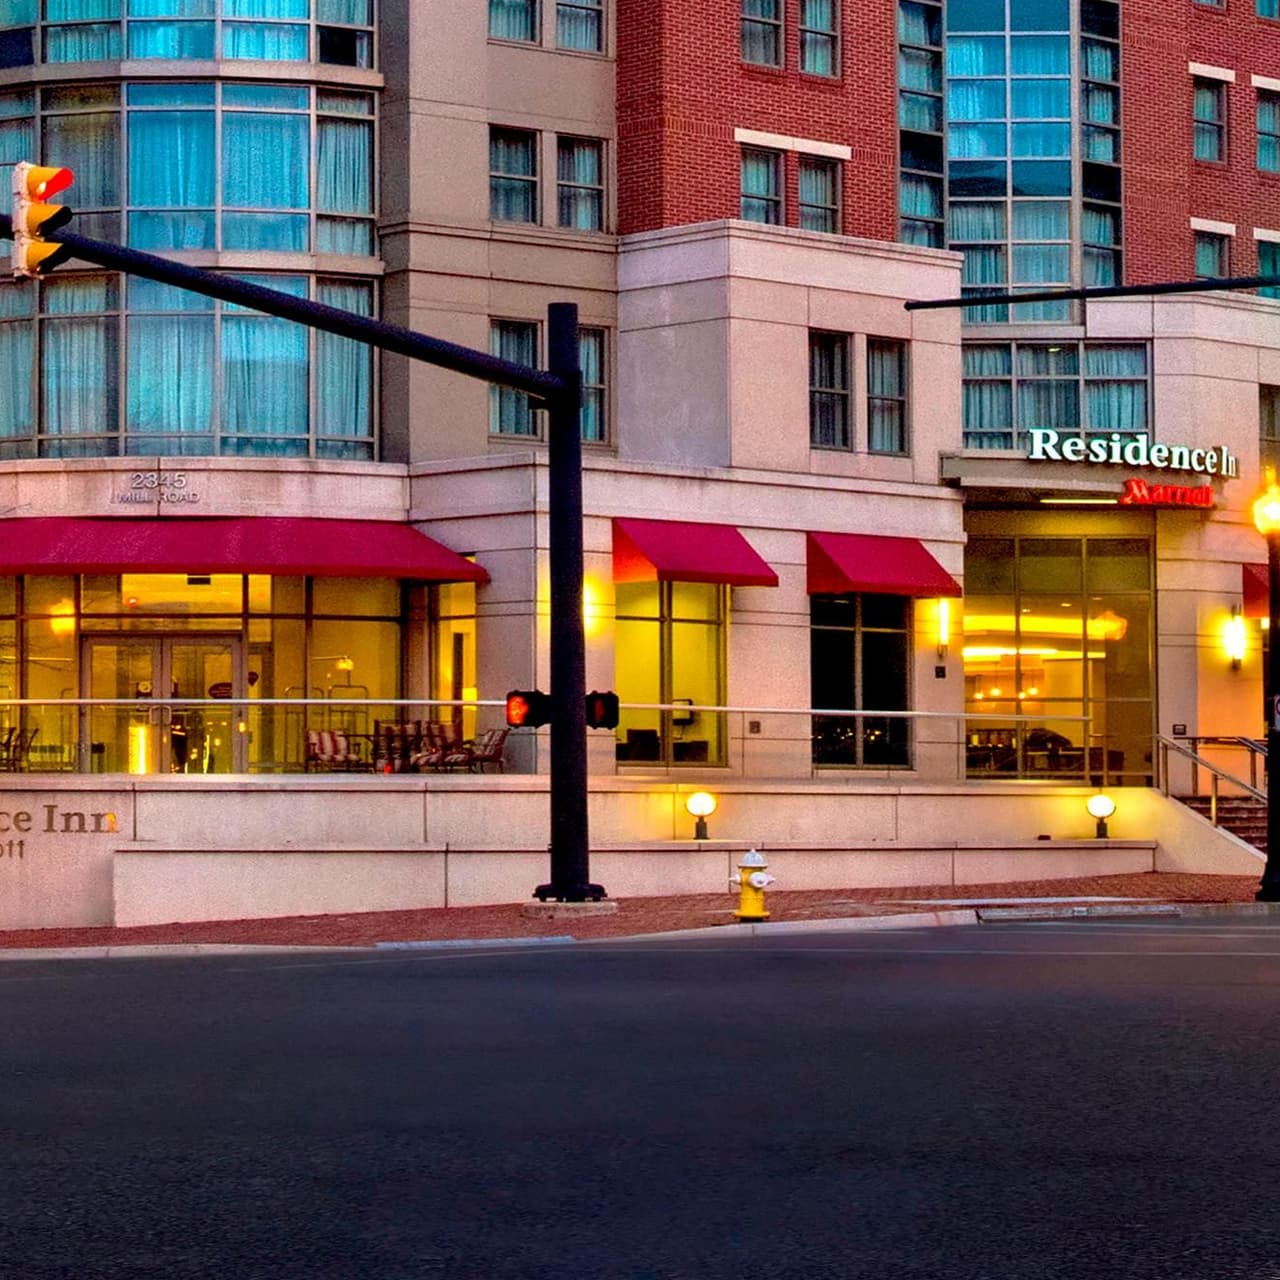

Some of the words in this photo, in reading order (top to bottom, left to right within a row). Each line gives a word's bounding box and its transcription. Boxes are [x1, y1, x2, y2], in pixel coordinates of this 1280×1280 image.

[1028, 428, 1218, 474] Residence
[131, 472, 187, 490] 2345
[159, 492, 201, 504] ROAD
[42, 804, 120, 834] Inn
